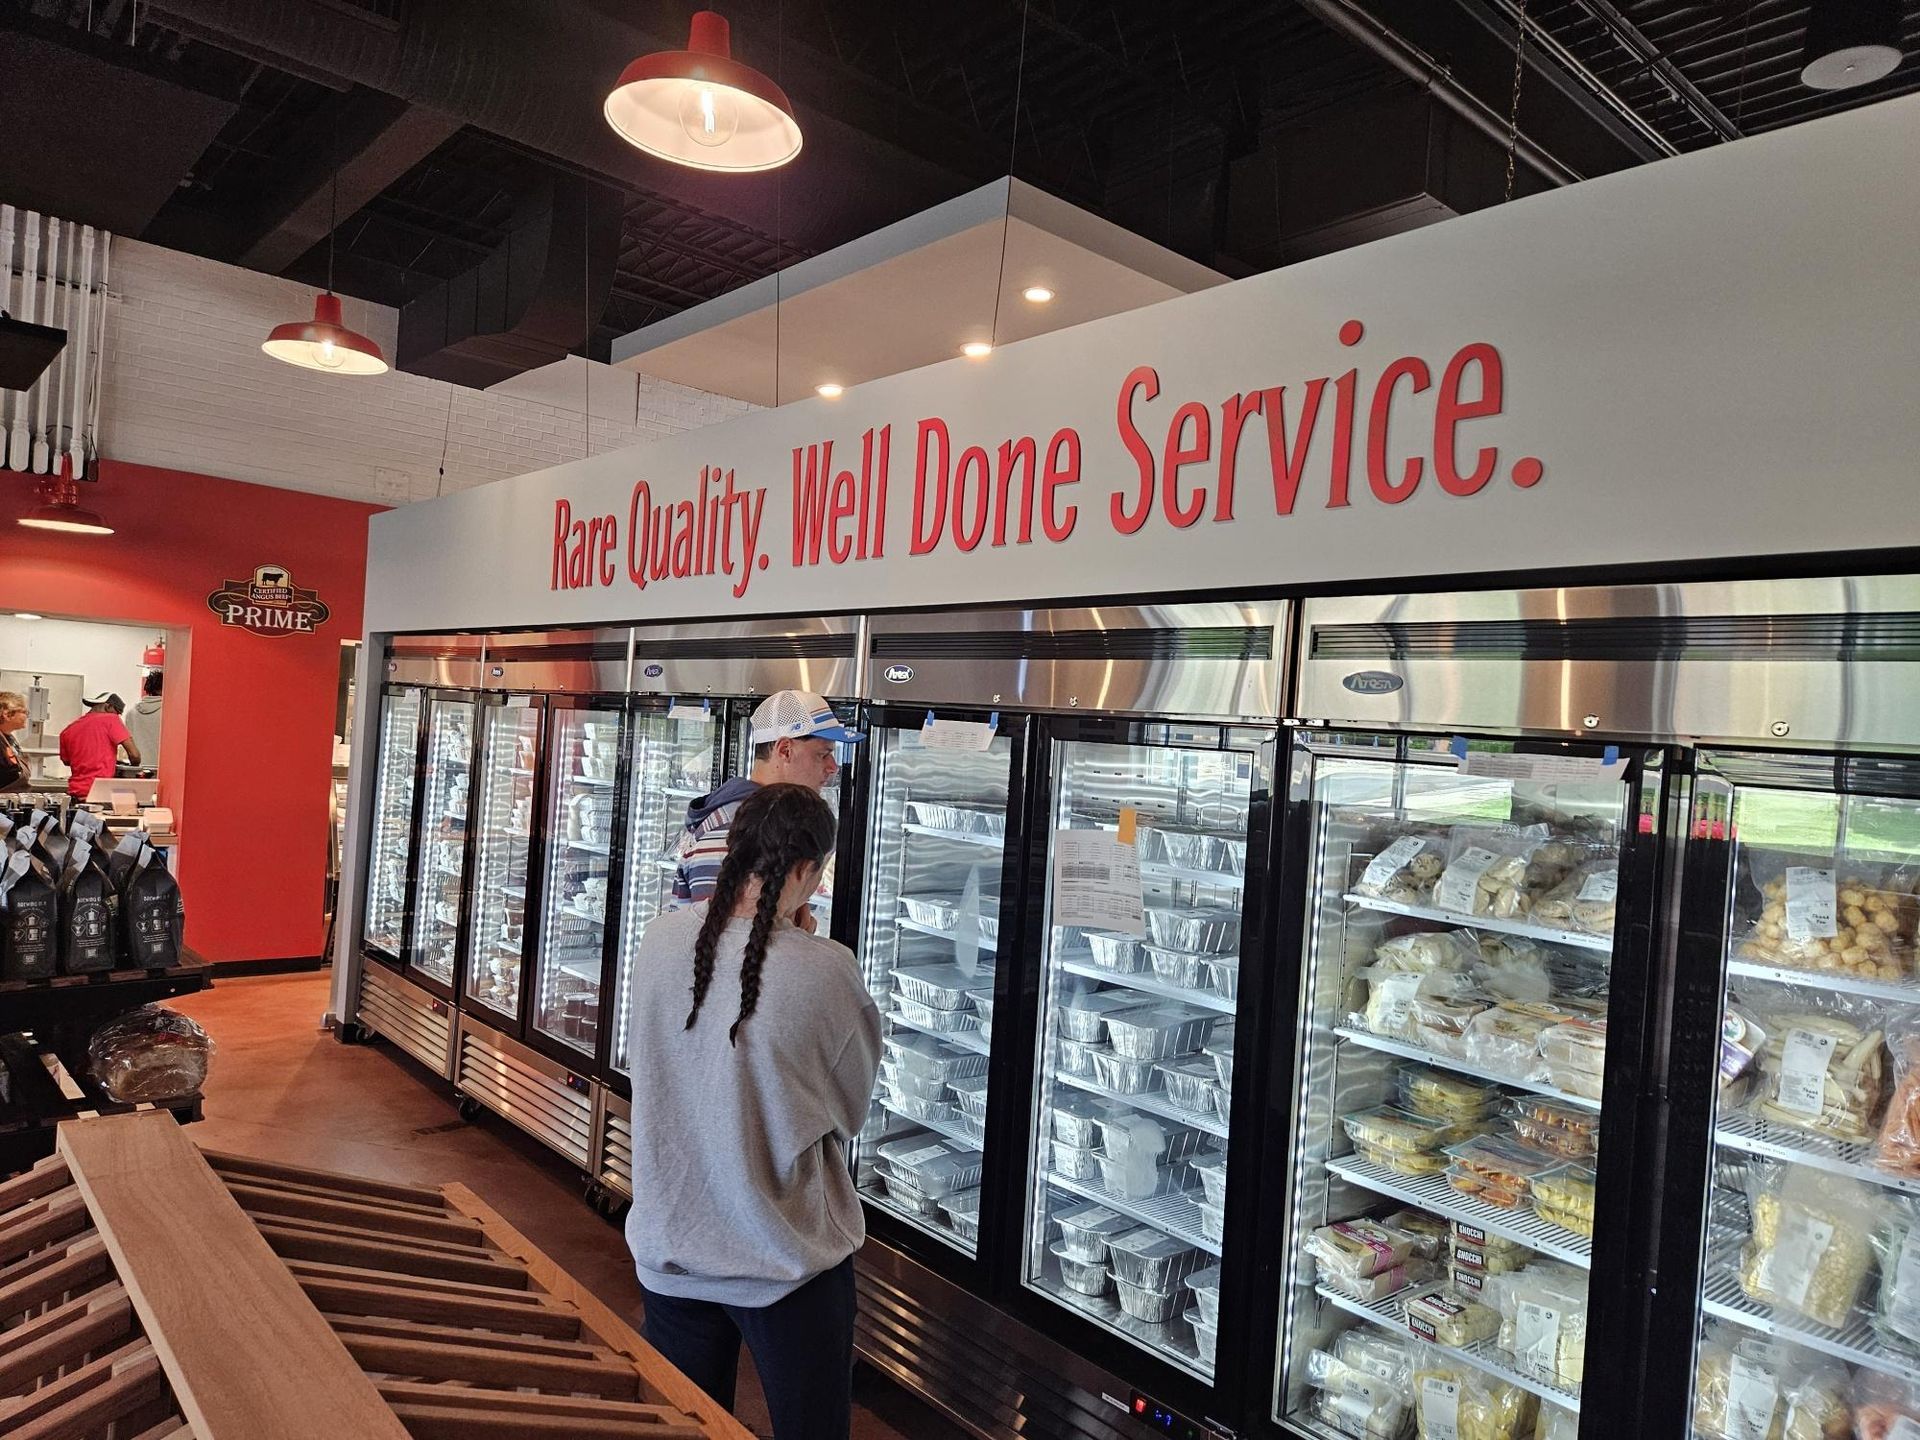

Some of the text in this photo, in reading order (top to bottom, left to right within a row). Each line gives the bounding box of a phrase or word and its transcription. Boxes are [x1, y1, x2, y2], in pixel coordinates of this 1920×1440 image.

[551, 319, 1544, 599] Rare Quality. Well Done Service.
[253, 587, 288, 595] CERTIFIED
[223, 604, 313, 632] PRIME
[1458, 1224, 1484, 1240] GNOCCHI
[1456, 1249, 1482, 1265] GNOCCHI
[1456, 1271, 1481, 1289] GNOCCHI
[1411, 1316, 1435, 1337] GNOCCHI
